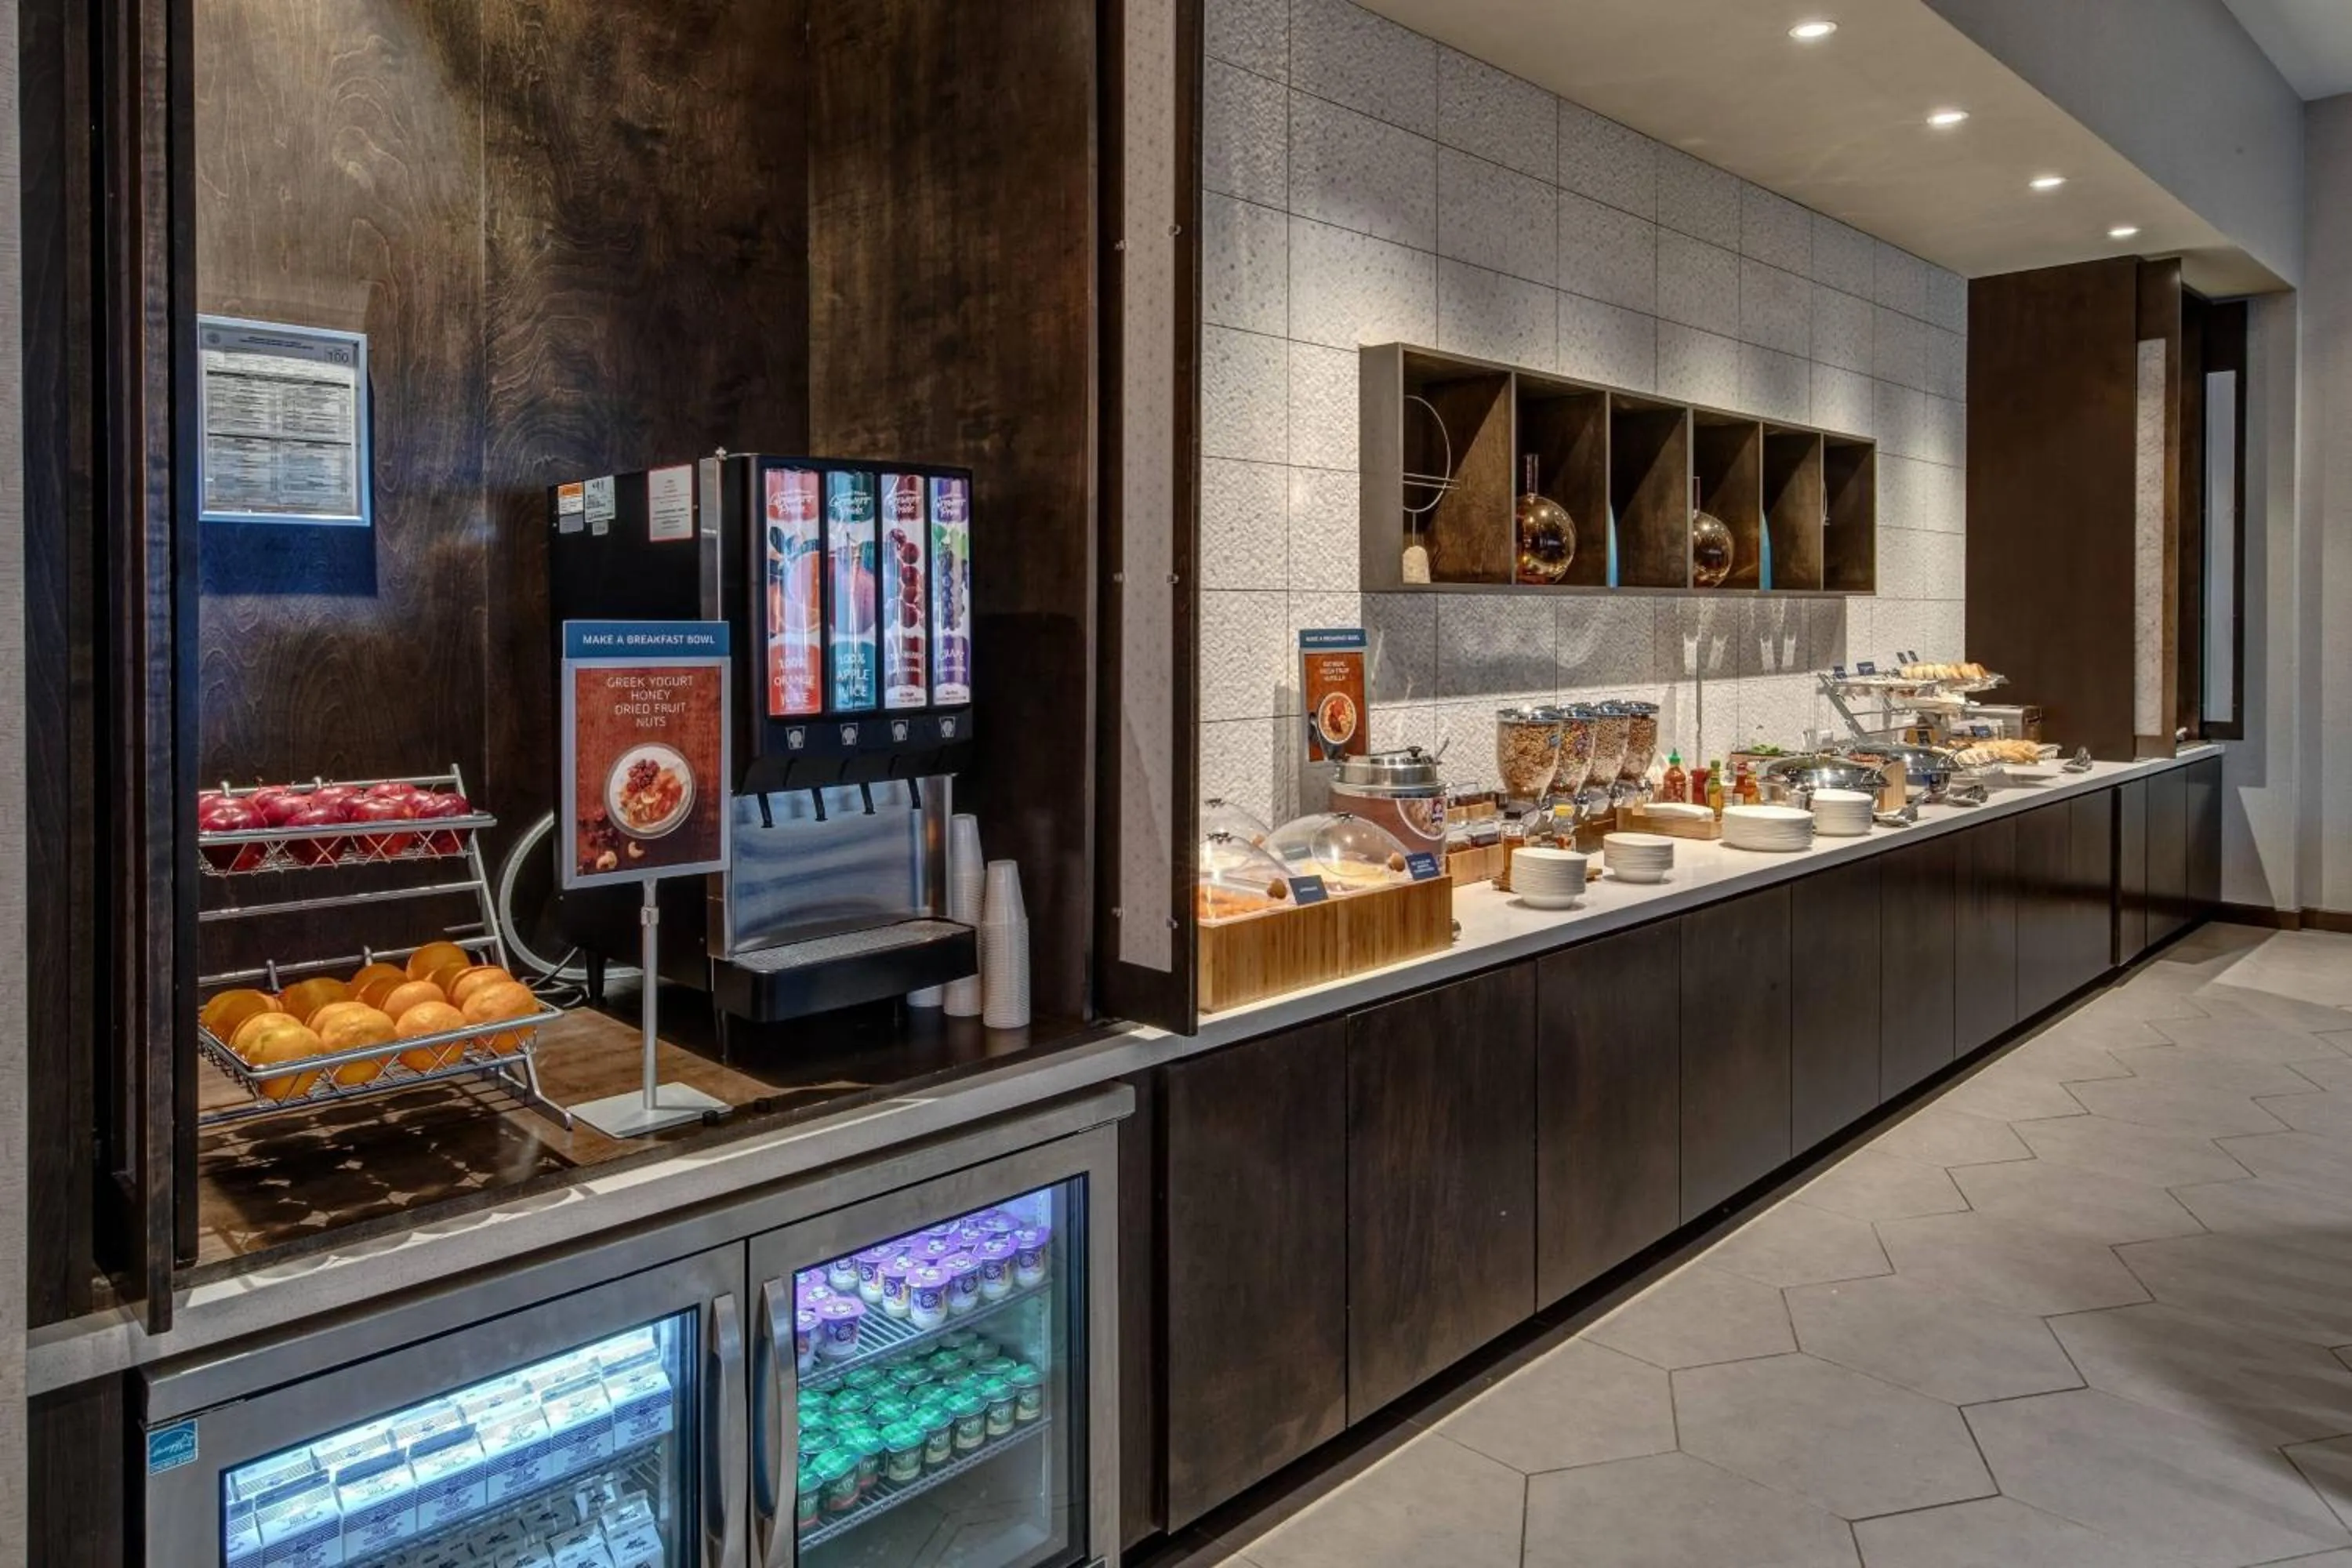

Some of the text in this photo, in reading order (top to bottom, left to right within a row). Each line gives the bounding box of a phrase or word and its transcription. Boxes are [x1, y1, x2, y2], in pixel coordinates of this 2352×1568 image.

[328, 350, 349, 364] 100
[583, 633, 716, 645] MAKE A BREAKFAST BOWL
[607, 675, 693, 688] GREEK YOGURT
[836, 669, 872, 682] APPLE
[630, 690, 671, 701] HONEY
[615, 702, 687, 715] DRIED FRUIT
[636, 716, 667, 728] NUTS
